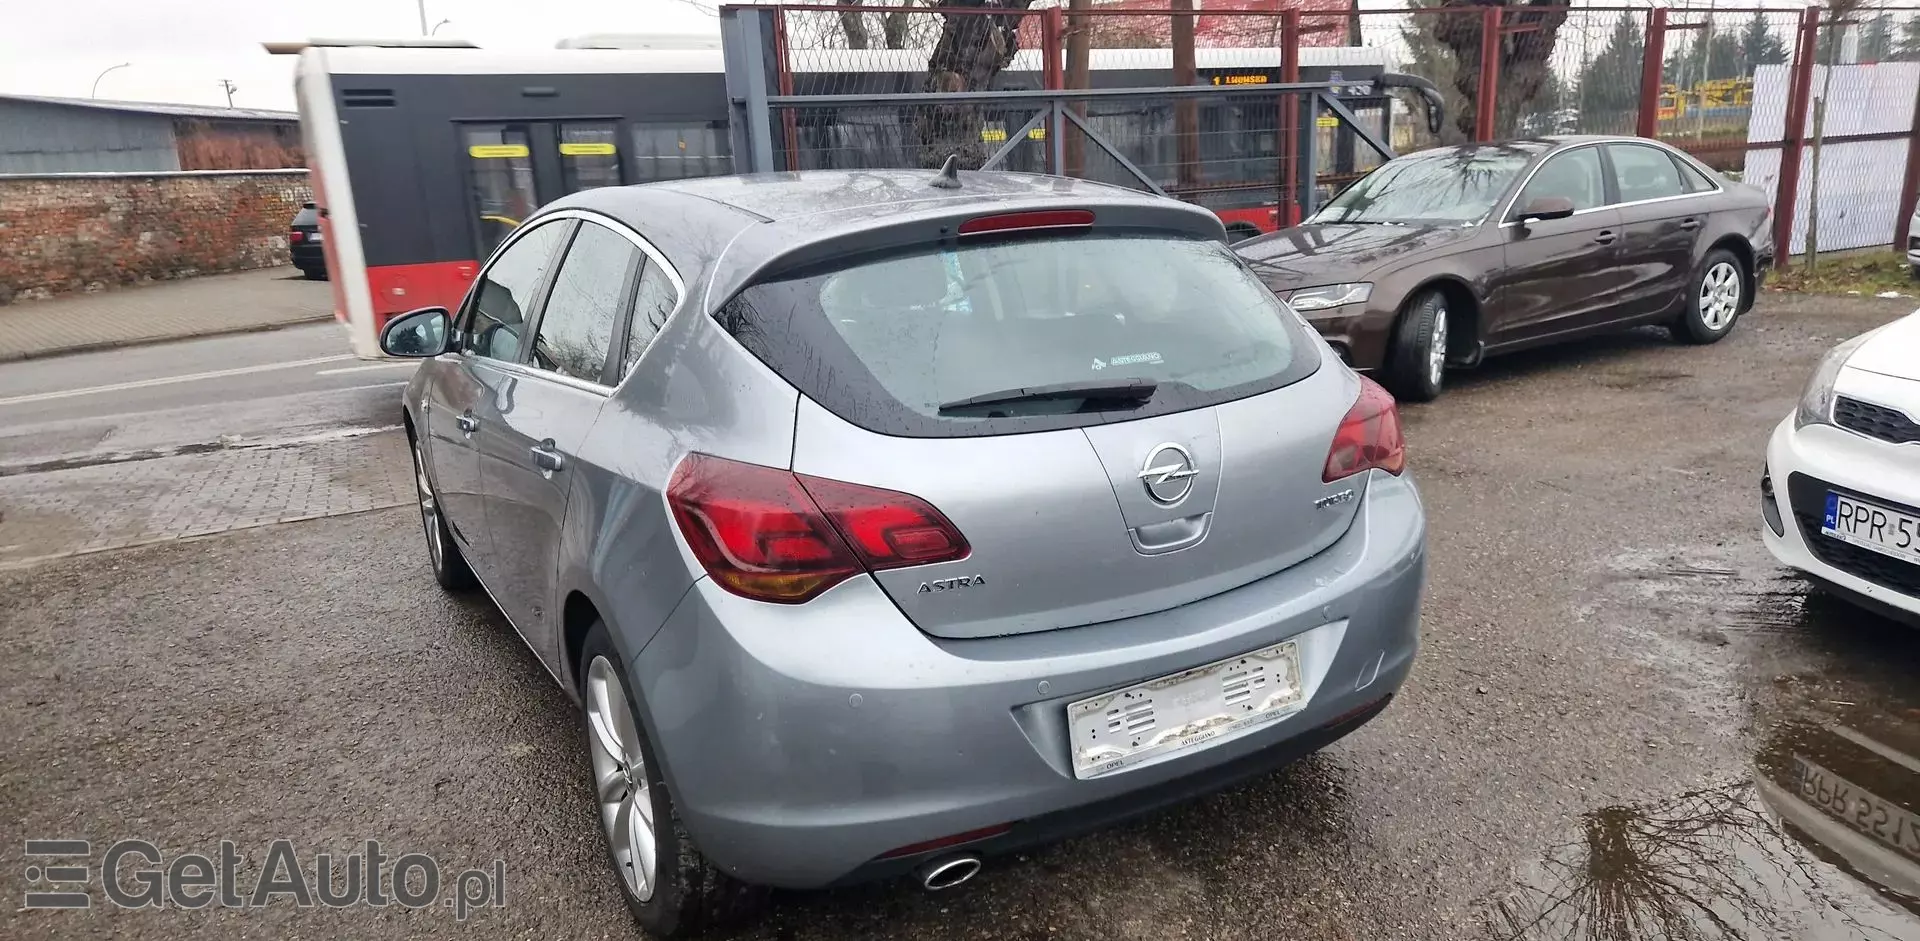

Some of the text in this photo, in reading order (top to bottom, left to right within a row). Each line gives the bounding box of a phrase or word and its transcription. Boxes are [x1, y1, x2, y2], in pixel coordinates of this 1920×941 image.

[1826, 514, 1836, 525] PL
[1837, 501, 1887, 543] RPR
[916, 574, 986, 595] ASTRA
